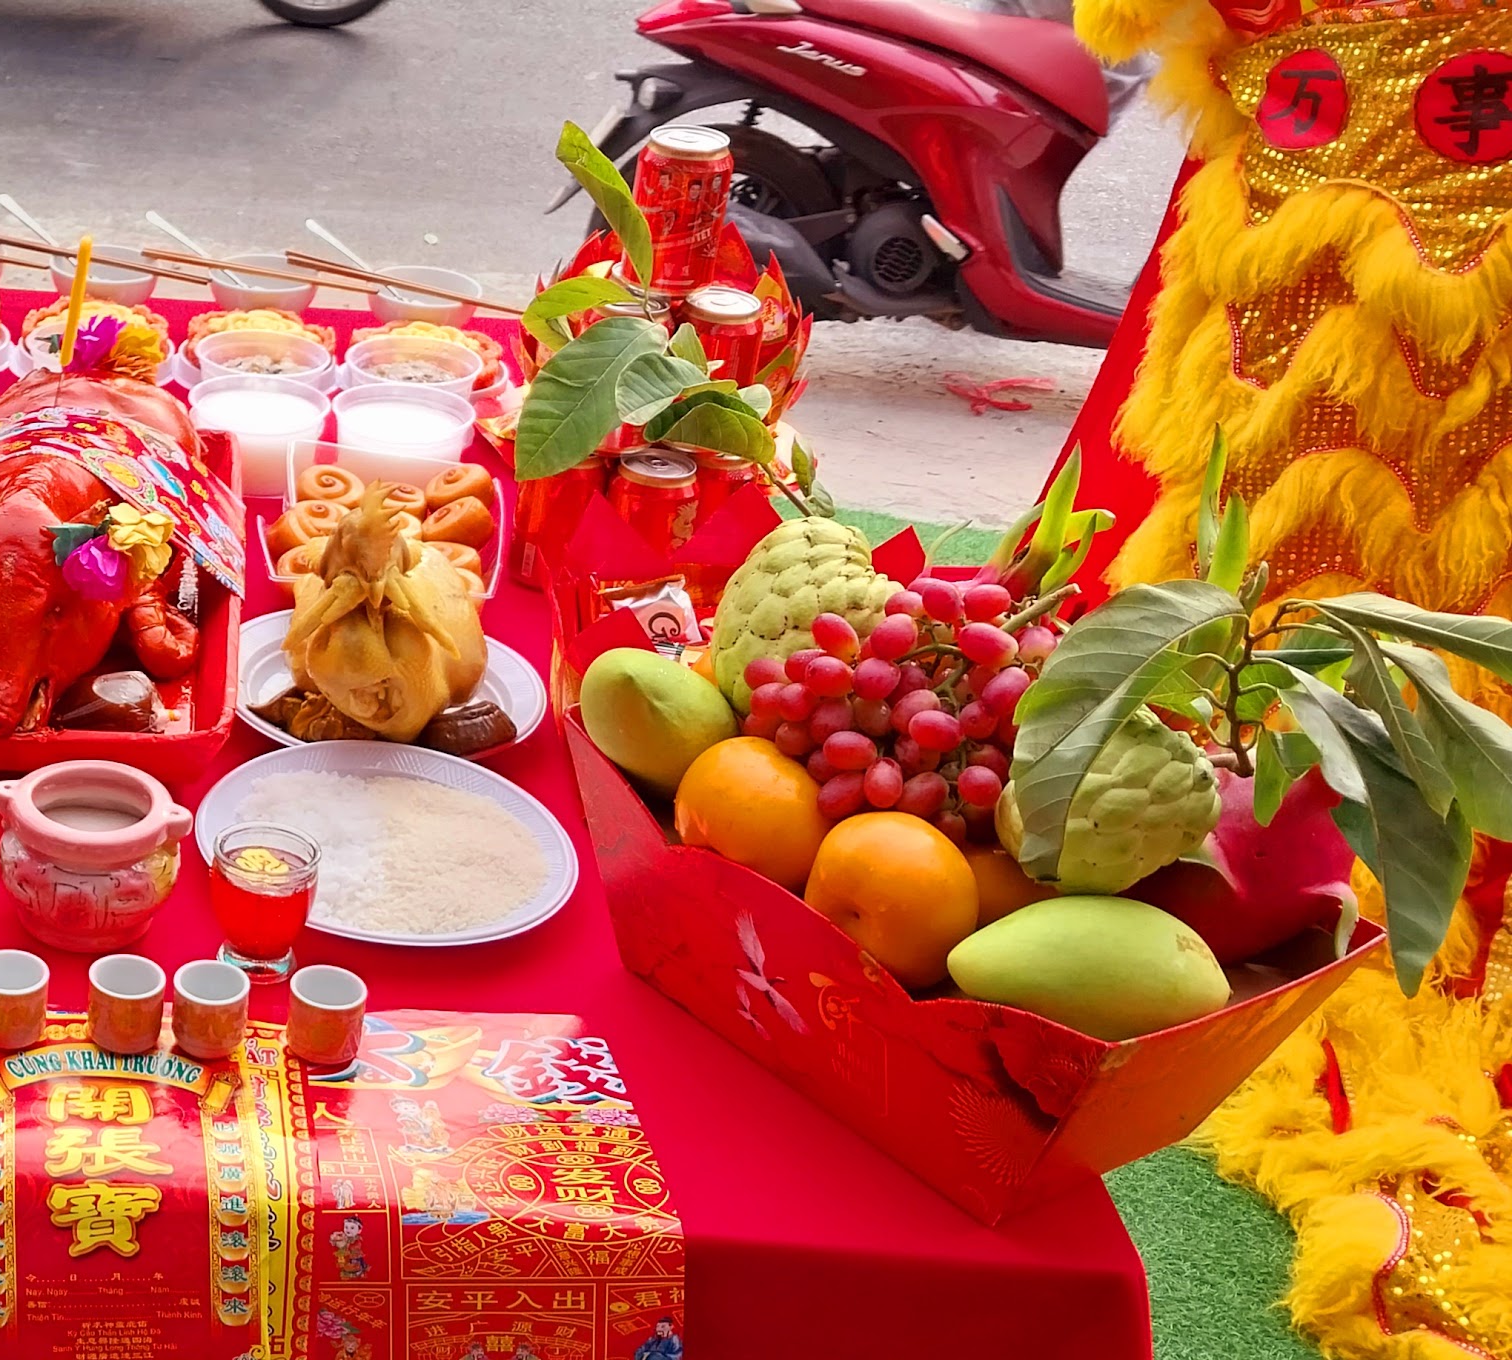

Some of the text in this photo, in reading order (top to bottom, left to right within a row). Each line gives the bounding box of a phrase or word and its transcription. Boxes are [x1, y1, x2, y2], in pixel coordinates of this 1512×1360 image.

[776, 41, 867, 76] Janus
[1266, 69, 1338, 135] 万
[66, 1051, 117, 1070] KHAI
[122, 1054, 202, 1084] TRƯƠNG
